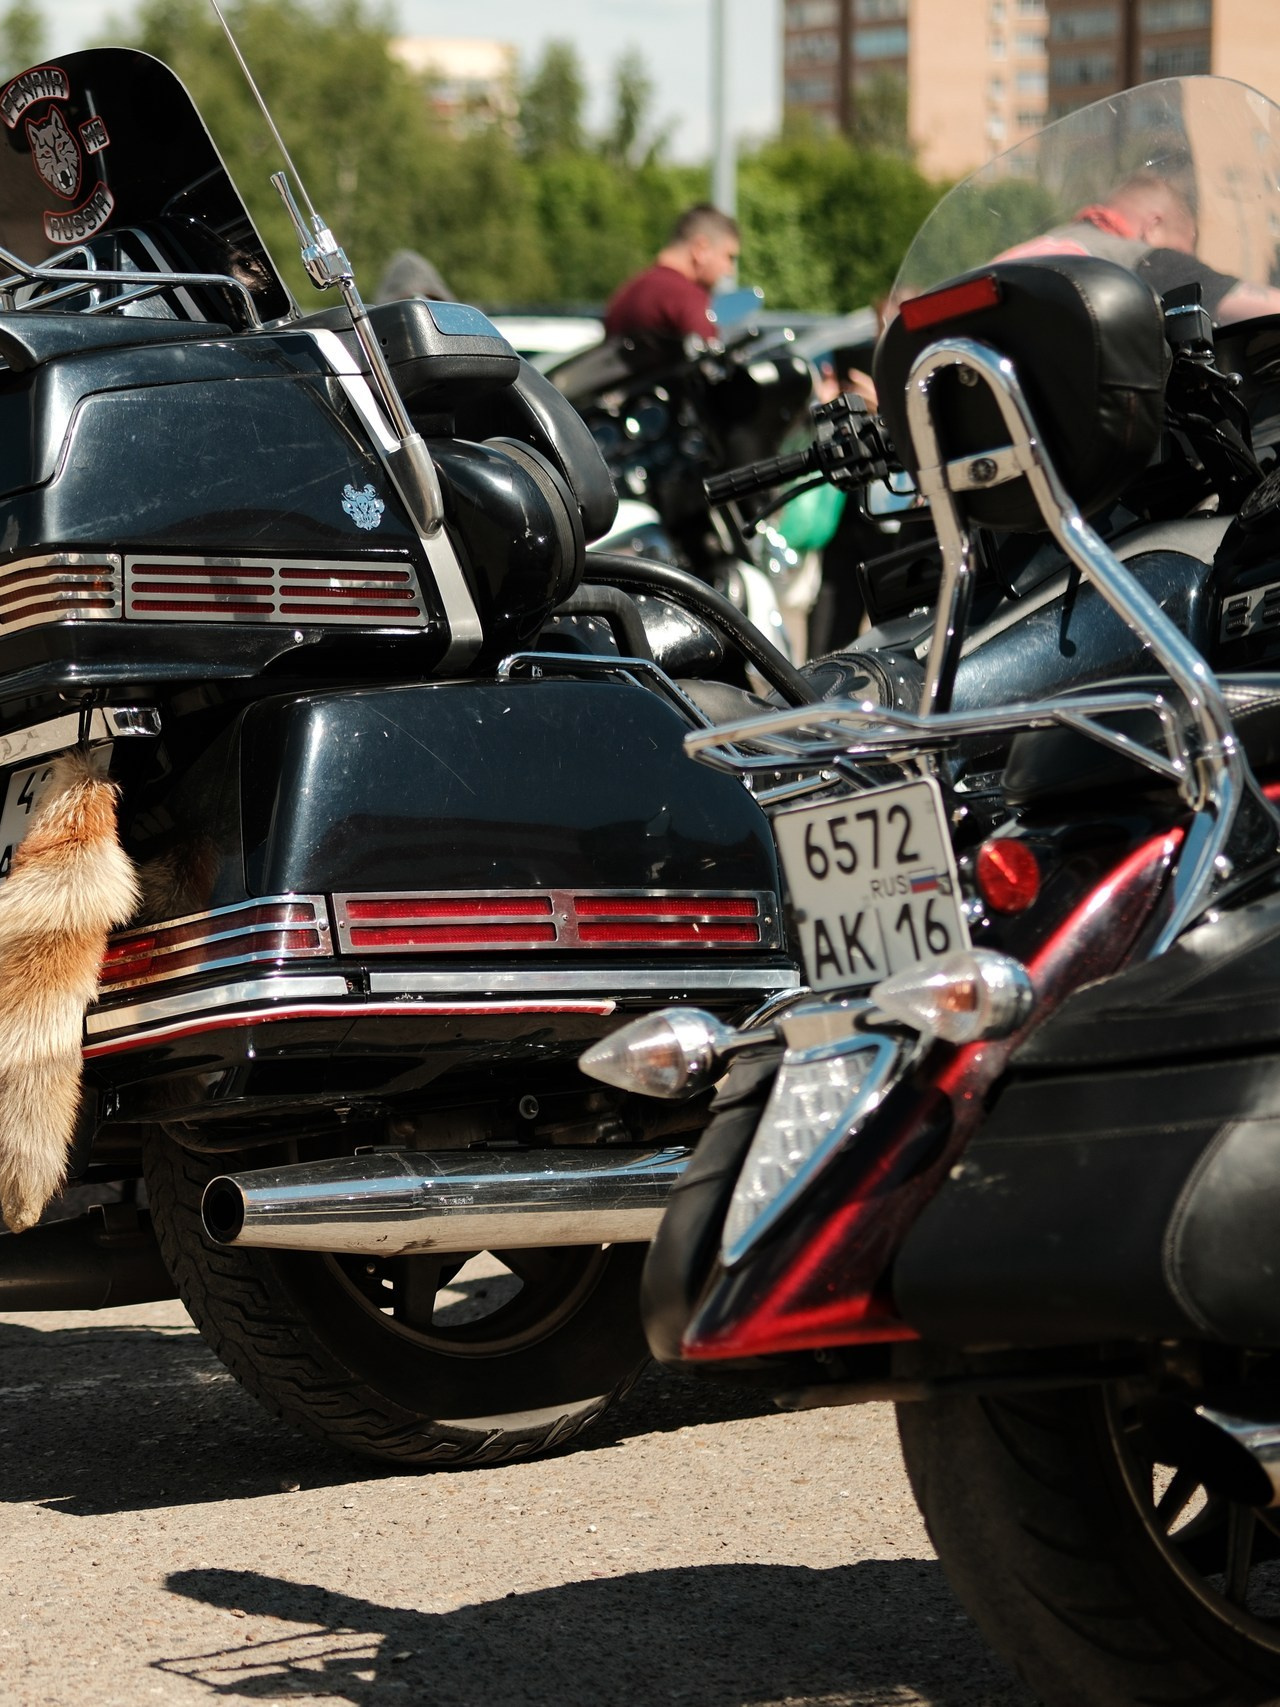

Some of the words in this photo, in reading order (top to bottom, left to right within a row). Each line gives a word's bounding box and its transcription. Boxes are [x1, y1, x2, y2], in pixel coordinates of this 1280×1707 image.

[0, 70, 64, 124] FENRIR
[50, 191, 112, 241] RUSSIA
[805, 805, 920, 880] 6572
[871, 876, 909, 899] RUS
[895, 899, 951, 962] 16
